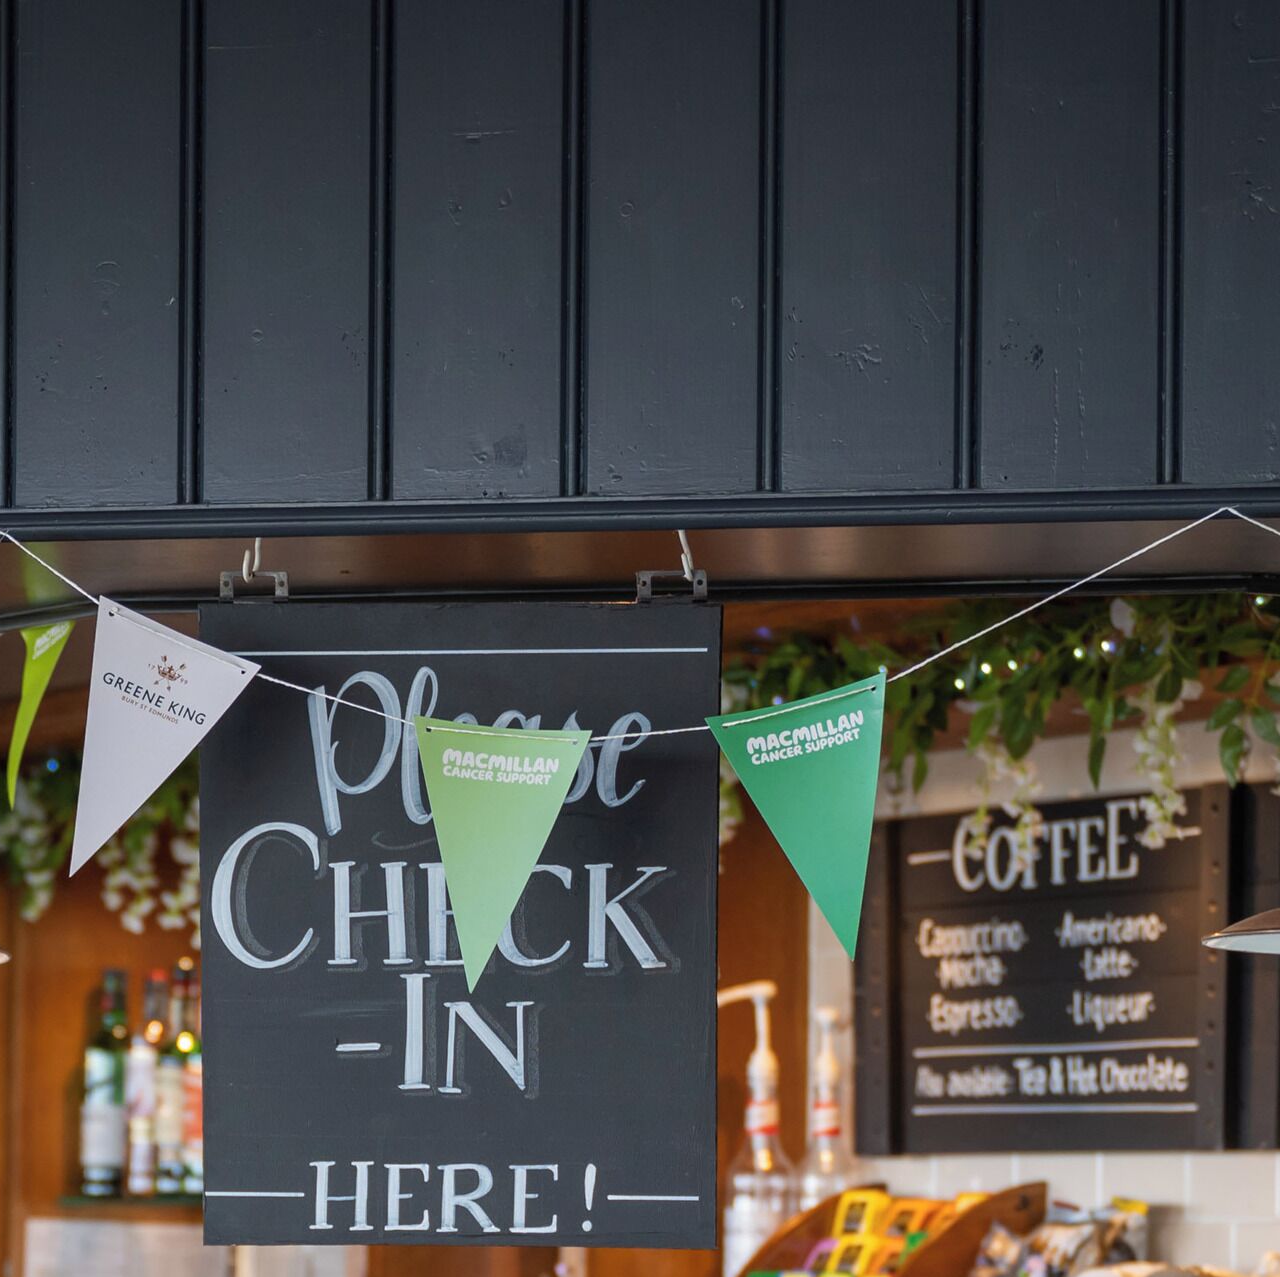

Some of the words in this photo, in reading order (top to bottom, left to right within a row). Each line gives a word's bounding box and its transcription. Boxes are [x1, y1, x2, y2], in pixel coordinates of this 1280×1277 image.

[102, 672, 165, 708] GREENE
[167, 700, 206, 725] KING
[746, 709, 864, 755] MACMILLAN
[751, 744, 804, 765] CANCER
[805, 728, 861, 754] SUPPORT
[442, 748, 560, 773] MACMILLAN
[442, 765, 494, 781] CANCER
[496, 771, 552, 785] SUPPORT
[952, 800, 1139, 892] COFFEE
[309, 1161, 598, 1235] HERE!
